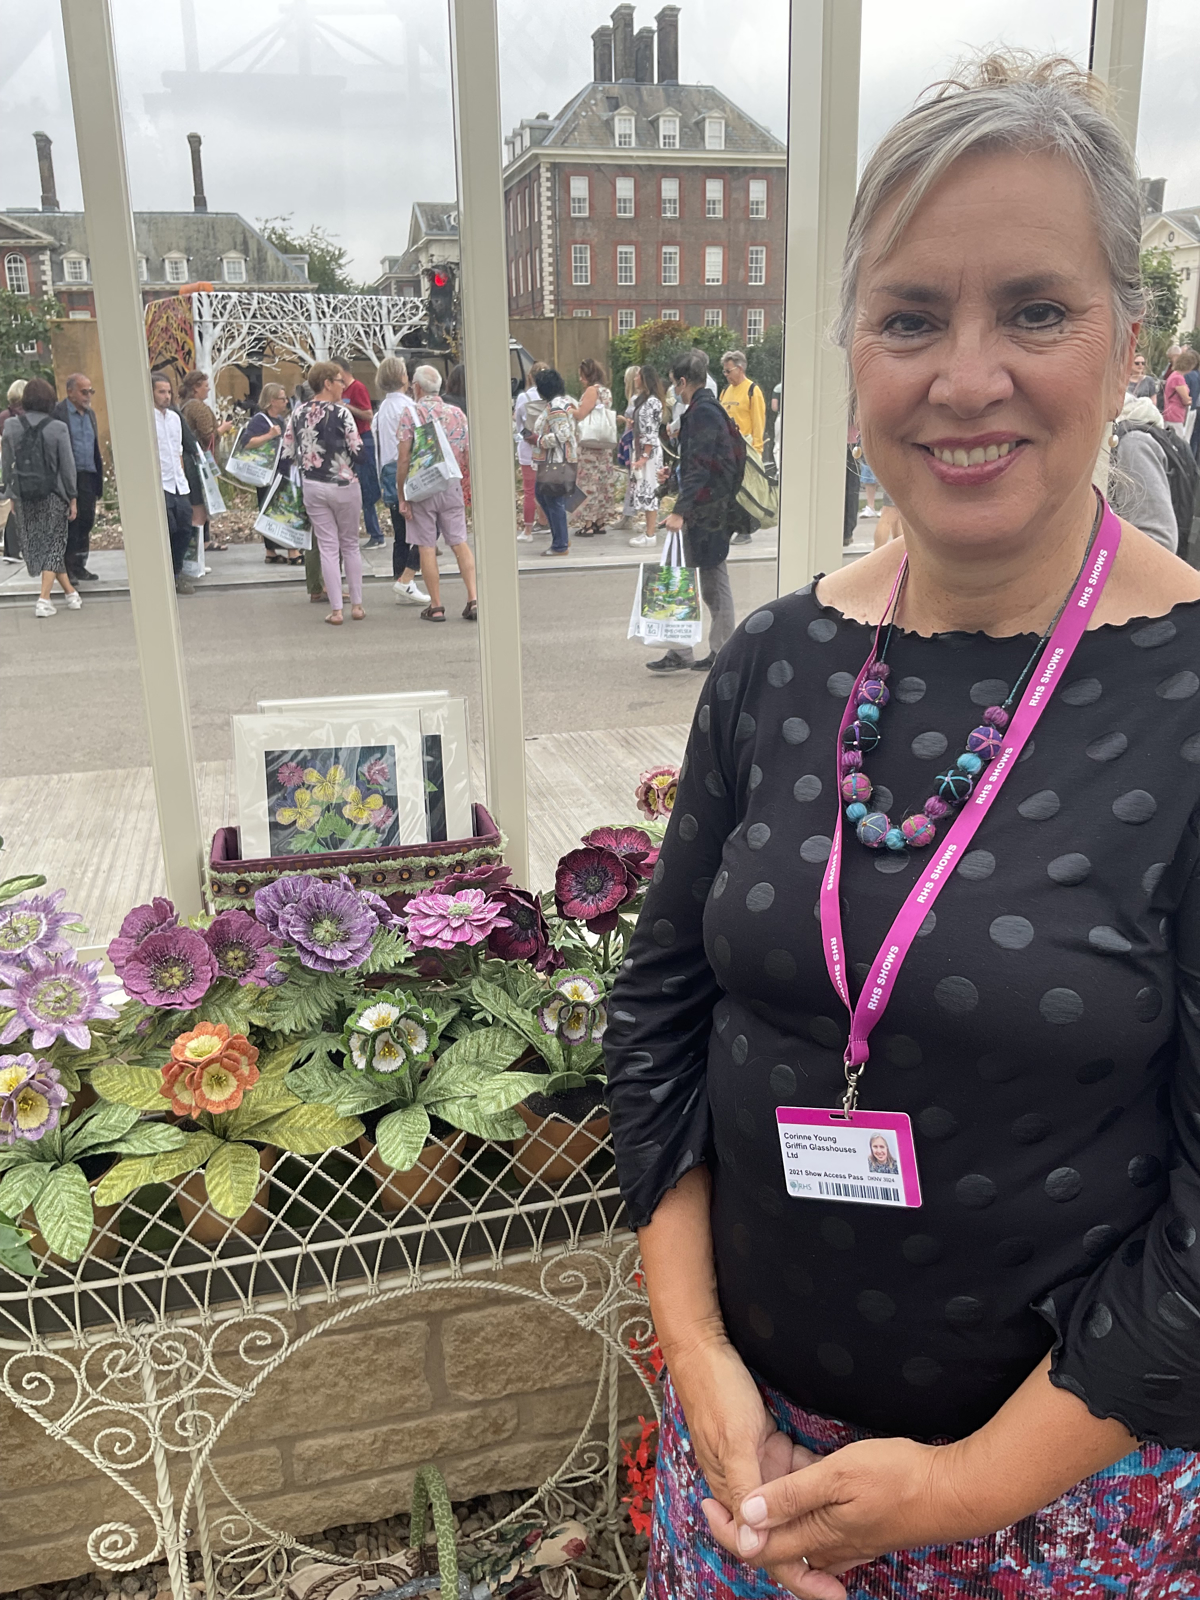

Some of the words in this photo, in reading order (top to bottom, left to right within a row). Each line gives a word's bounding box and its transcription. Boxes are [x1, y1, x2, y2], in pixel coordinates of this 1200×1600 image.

[1077, 586, 1093, 608] RHS
[1088, 549, 1108, 586] SHOWS
[1029, 685, 1045, 707] RHS
[1040, 647, 1064, 684] SHOWS
[975, 784, 993, 805] RHS
[989, 747, 1014, 782] SHOWS
[916, 881, 934, 904] RHS
[930, 844, 957, 881] SHOWS
[830, 937, 839, 962] RHS
[867, 986, 883, 1010] RHS
[876, 945, 899, 986] SHOWS
[783, 1132, 812, 1141] Corinne
[813, 1134, 837, 1144] Young
[785, 1142, 808, 1150] Griffin
[809, 1143, 857, 1153] Glasshouses
[799, 1182, 812, 1190] RHS
[823, 1171, 847, 1180] Access
[848, 1172, 864, 1181] Pass
